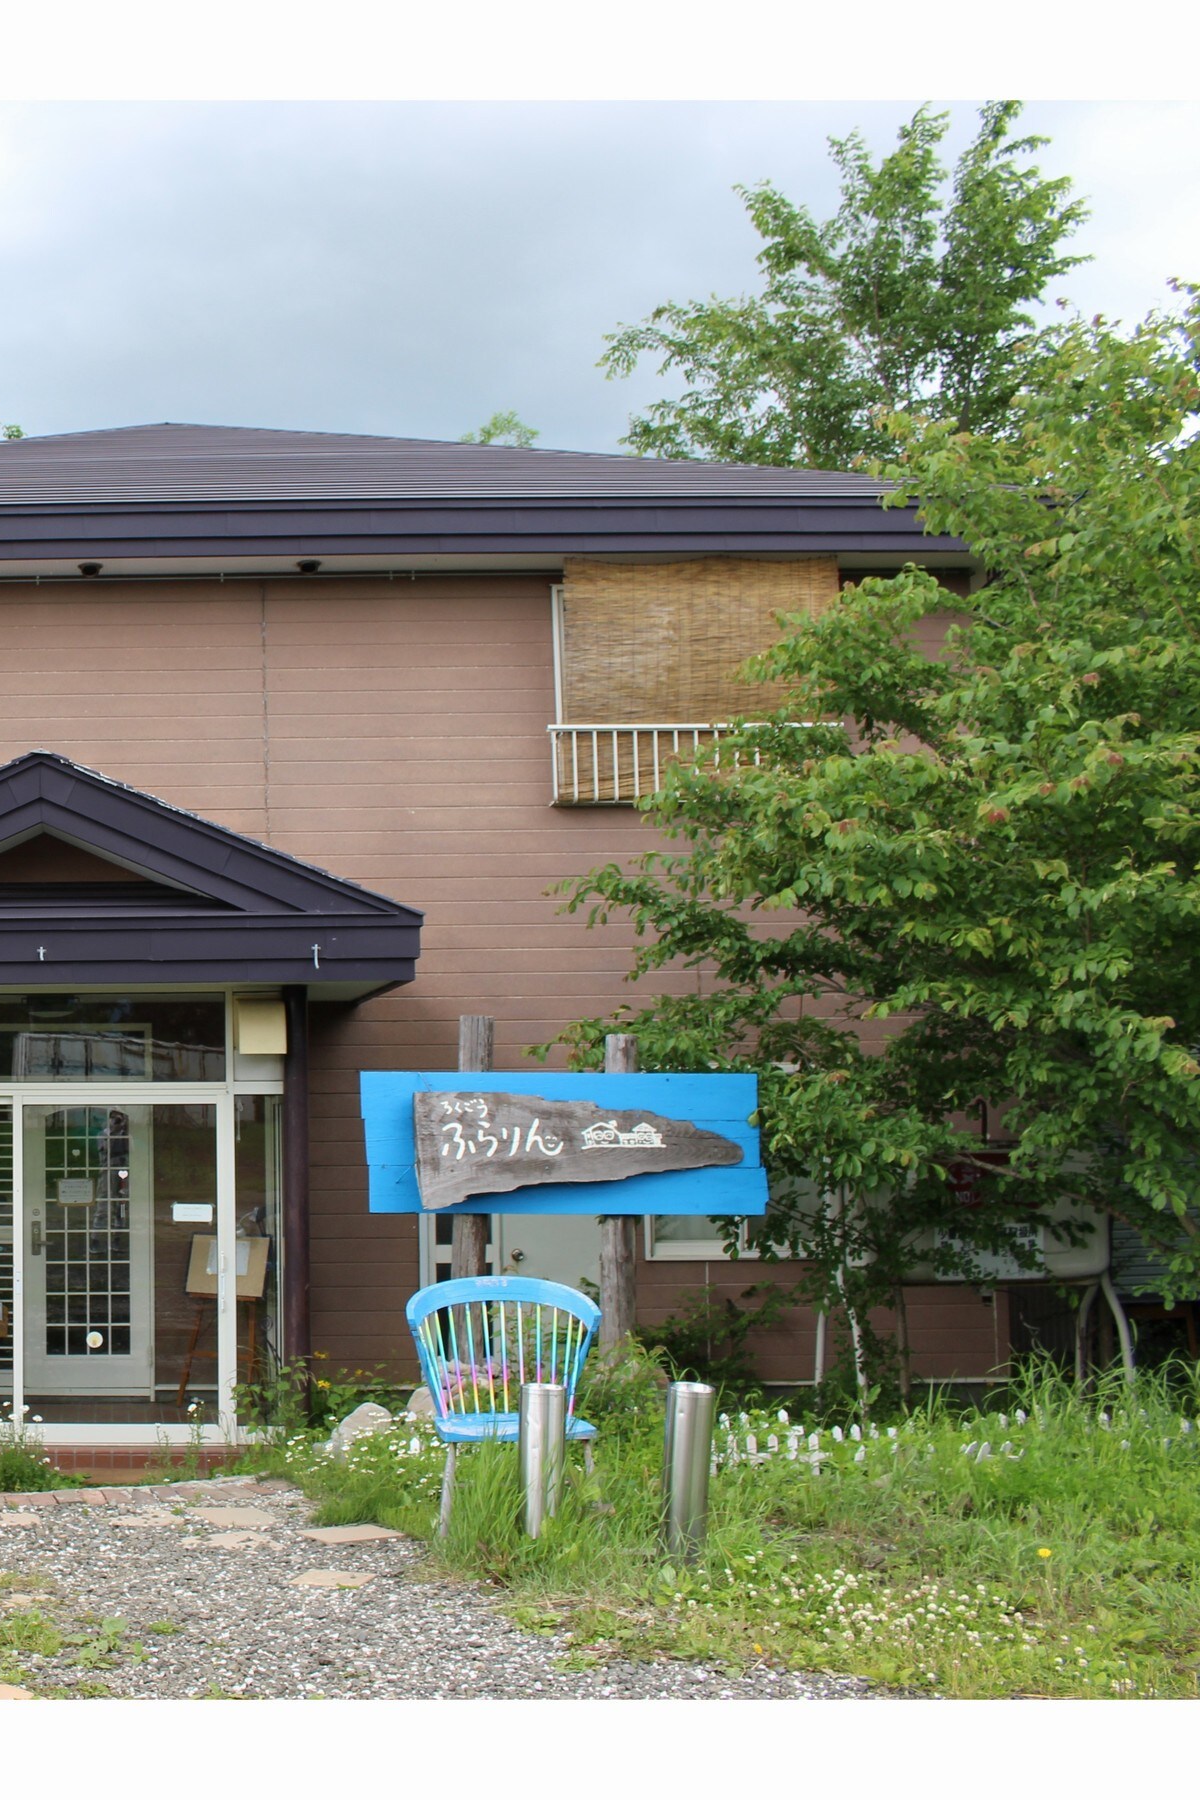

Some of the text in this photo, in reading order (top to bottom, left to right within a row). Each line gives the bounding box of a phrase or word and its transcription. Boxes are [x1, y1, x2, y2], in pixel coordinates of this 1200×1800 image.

[440, 1098, 488, 1118] ろくごう
[441, 1117, 564, 1160] ふらりん
